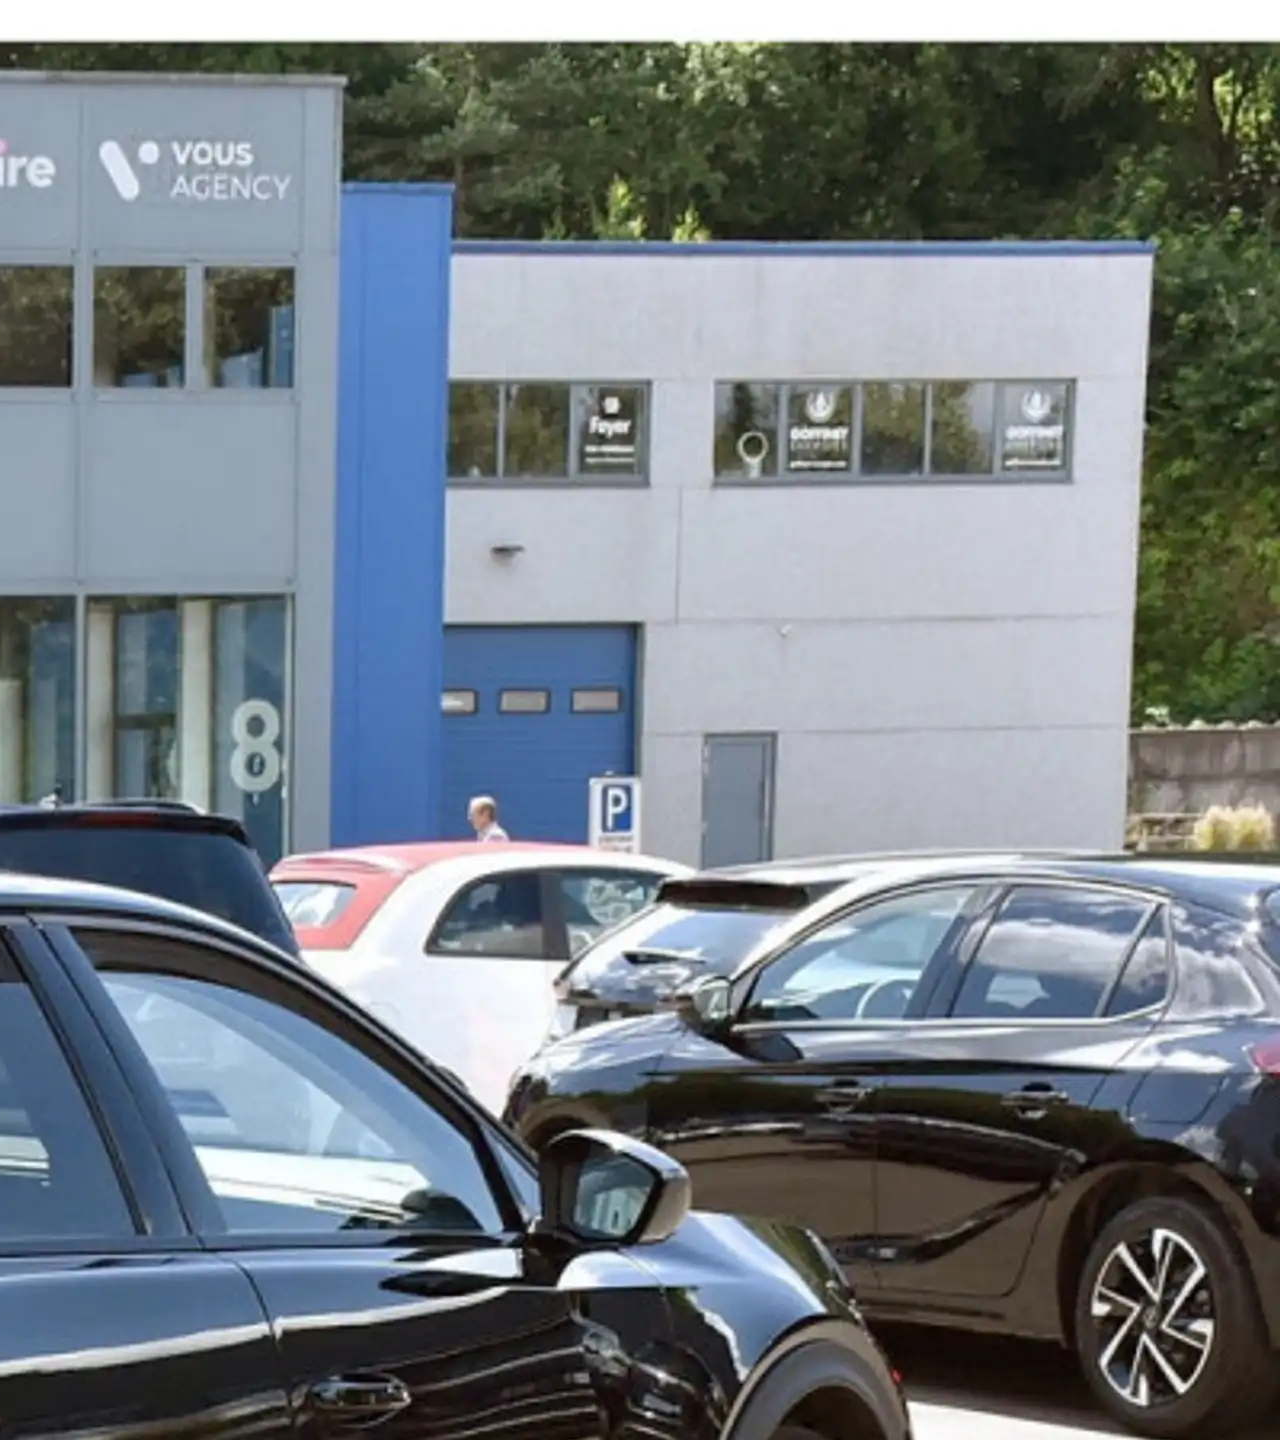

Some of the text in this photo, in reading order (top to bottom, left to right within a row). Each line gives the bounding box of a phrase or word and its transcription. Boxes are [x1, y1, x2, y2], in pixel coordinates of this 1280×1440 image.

[171, 141, 254, 166] VOUS
[170, 174, 292, 200] AGENCY
[230, 700, 280, 792] 8
[606, 787, 628, 830] P
